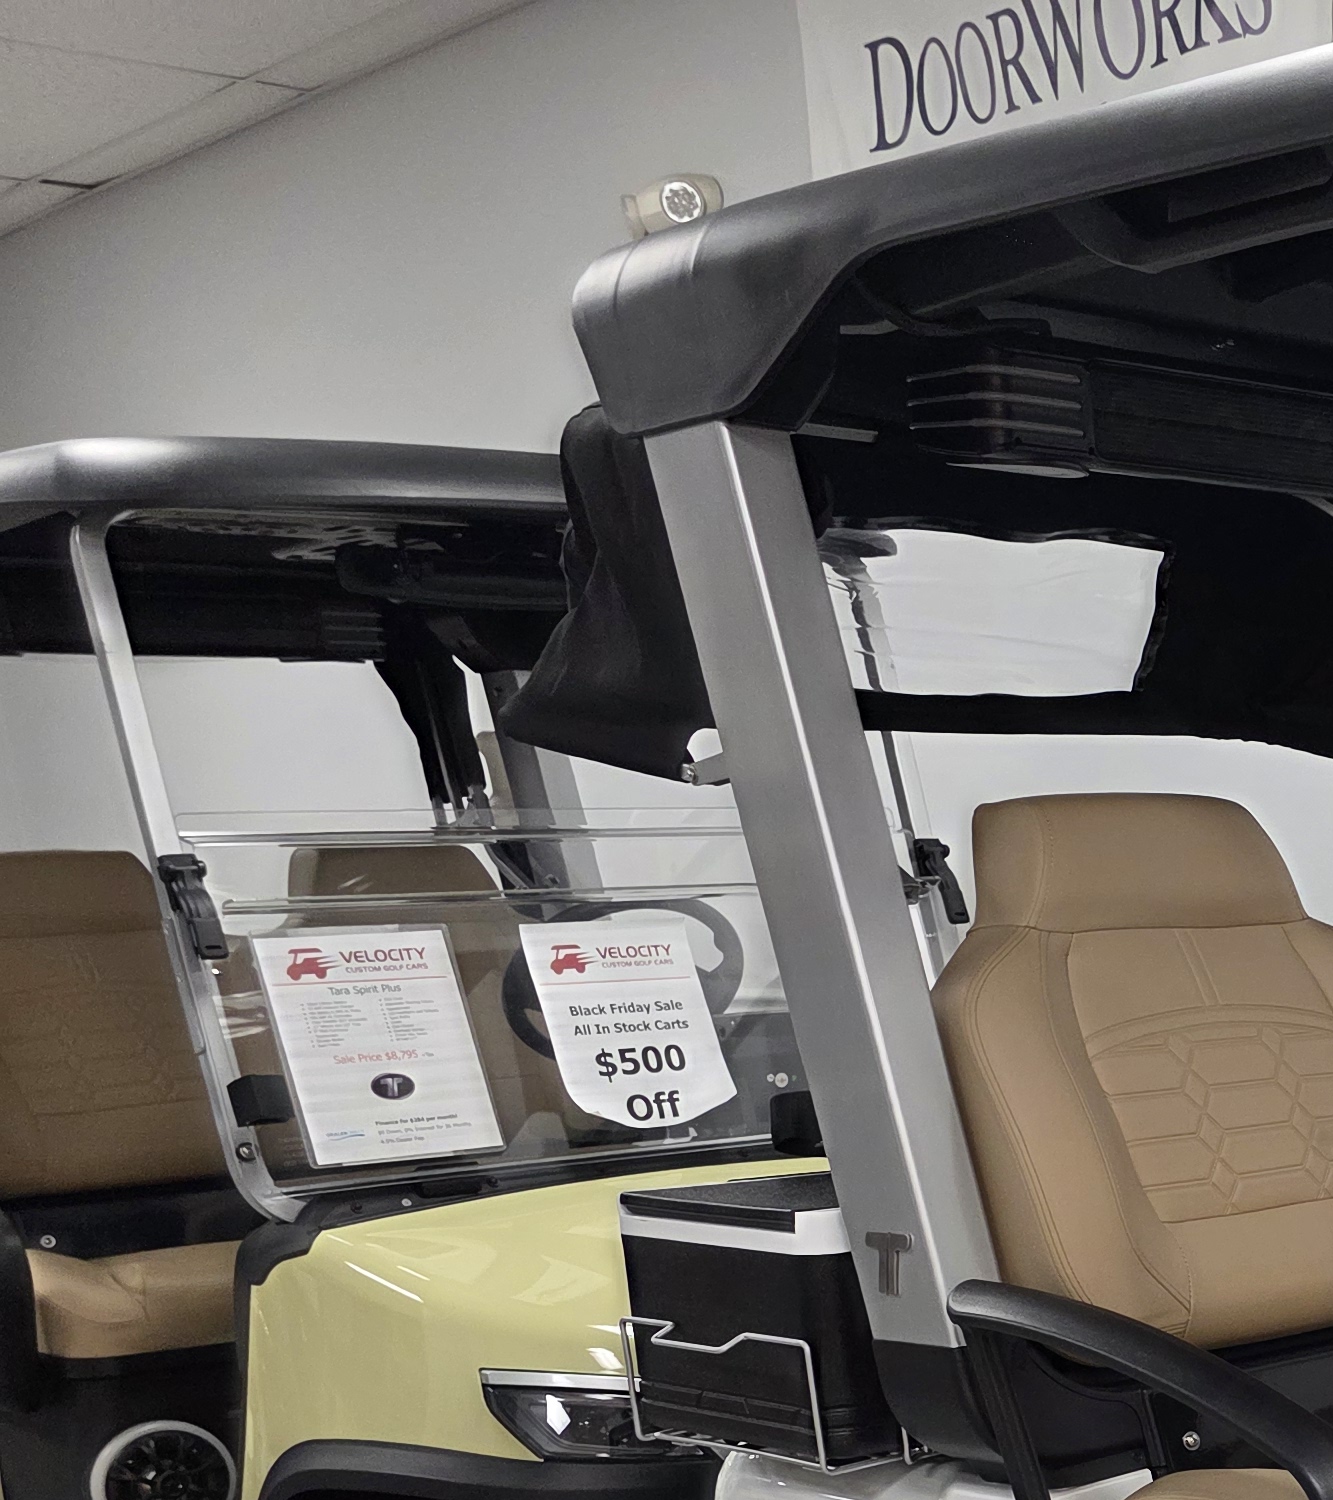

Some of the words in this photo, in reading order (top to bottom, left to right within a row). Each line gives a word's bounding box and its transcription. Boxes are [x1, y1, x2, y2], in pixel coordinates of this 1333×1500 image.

[338, 946, 426, 964] VELOCITY
[595, 944, 671, 960] VELOCITY
[345, 965, 382, 974] CUSTOM
[382, 964, 404, 972] GOLF
[405, 962, 429, 971] CARS
[601, 961, 633, 969] CUSTOM
[654, 958, 675, 966] CARS
[327, 986, 351, 996] Tara
[352, 985, 380, 996] Spirit
[380, 984, 402, 993] Plus
[568, 1003, 607, 1017] Black
[609, 1001, 651, 1015] Friday
[654, 999, 684, 1012] Sale
[574, 1023, 592, 1036] All
[594, 1023, 611, 1035] In
[613, 1020, 652, 1034] Stock
[654, 1019, 690, 1031] Carts
[333, 1054, 357, 1065] Sale
[357, 1051, 383, 1063] Price
[385, 1049, 419, 1062] $8,795
[595, 1044, 687, 1083] $500
[626, 1089, 681, 1122] Off
